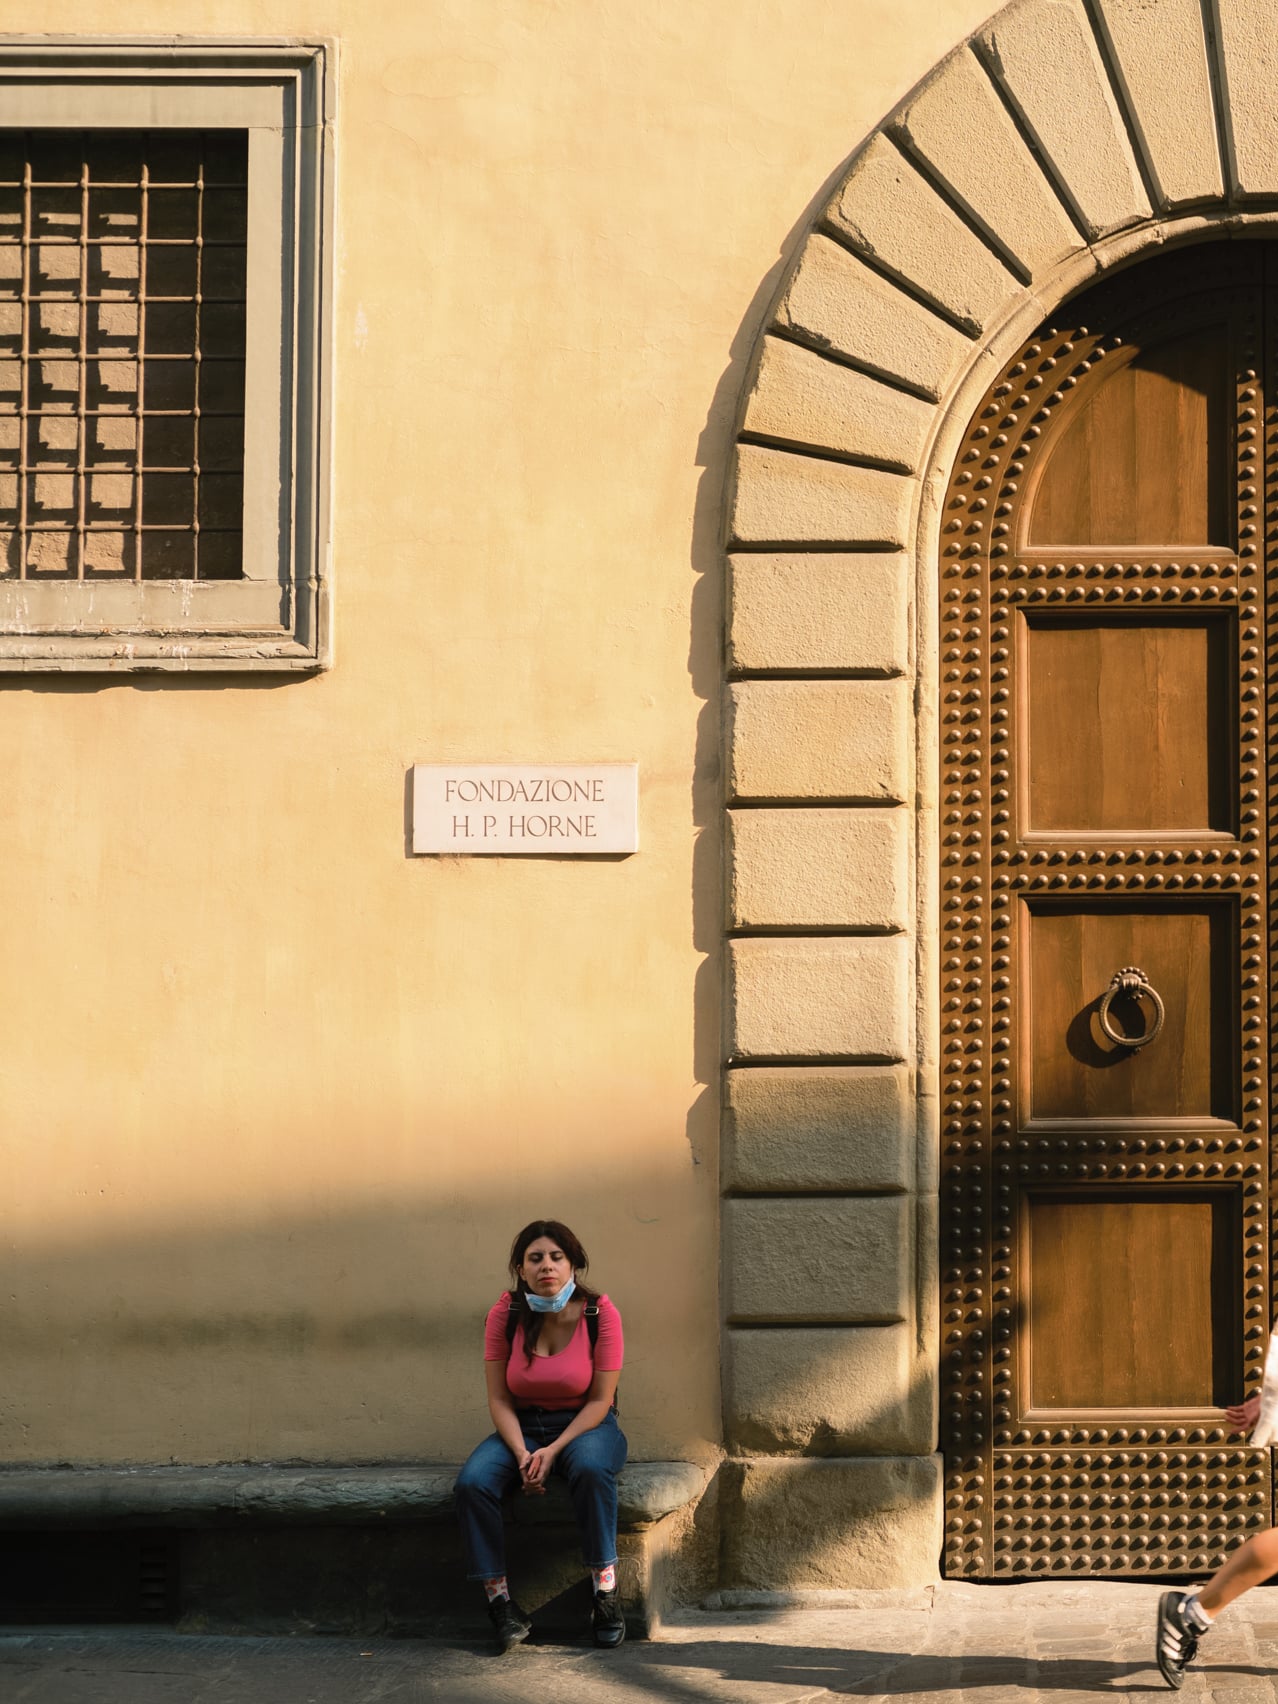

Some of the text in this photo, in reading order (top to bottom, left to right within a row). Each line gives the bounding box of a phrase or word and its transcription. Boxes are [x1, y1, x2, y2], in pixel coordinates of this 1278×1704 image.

[445, 779, 605, 802] FONDAZIONE
[453, 815, 597, 838] H. P. HORNE
